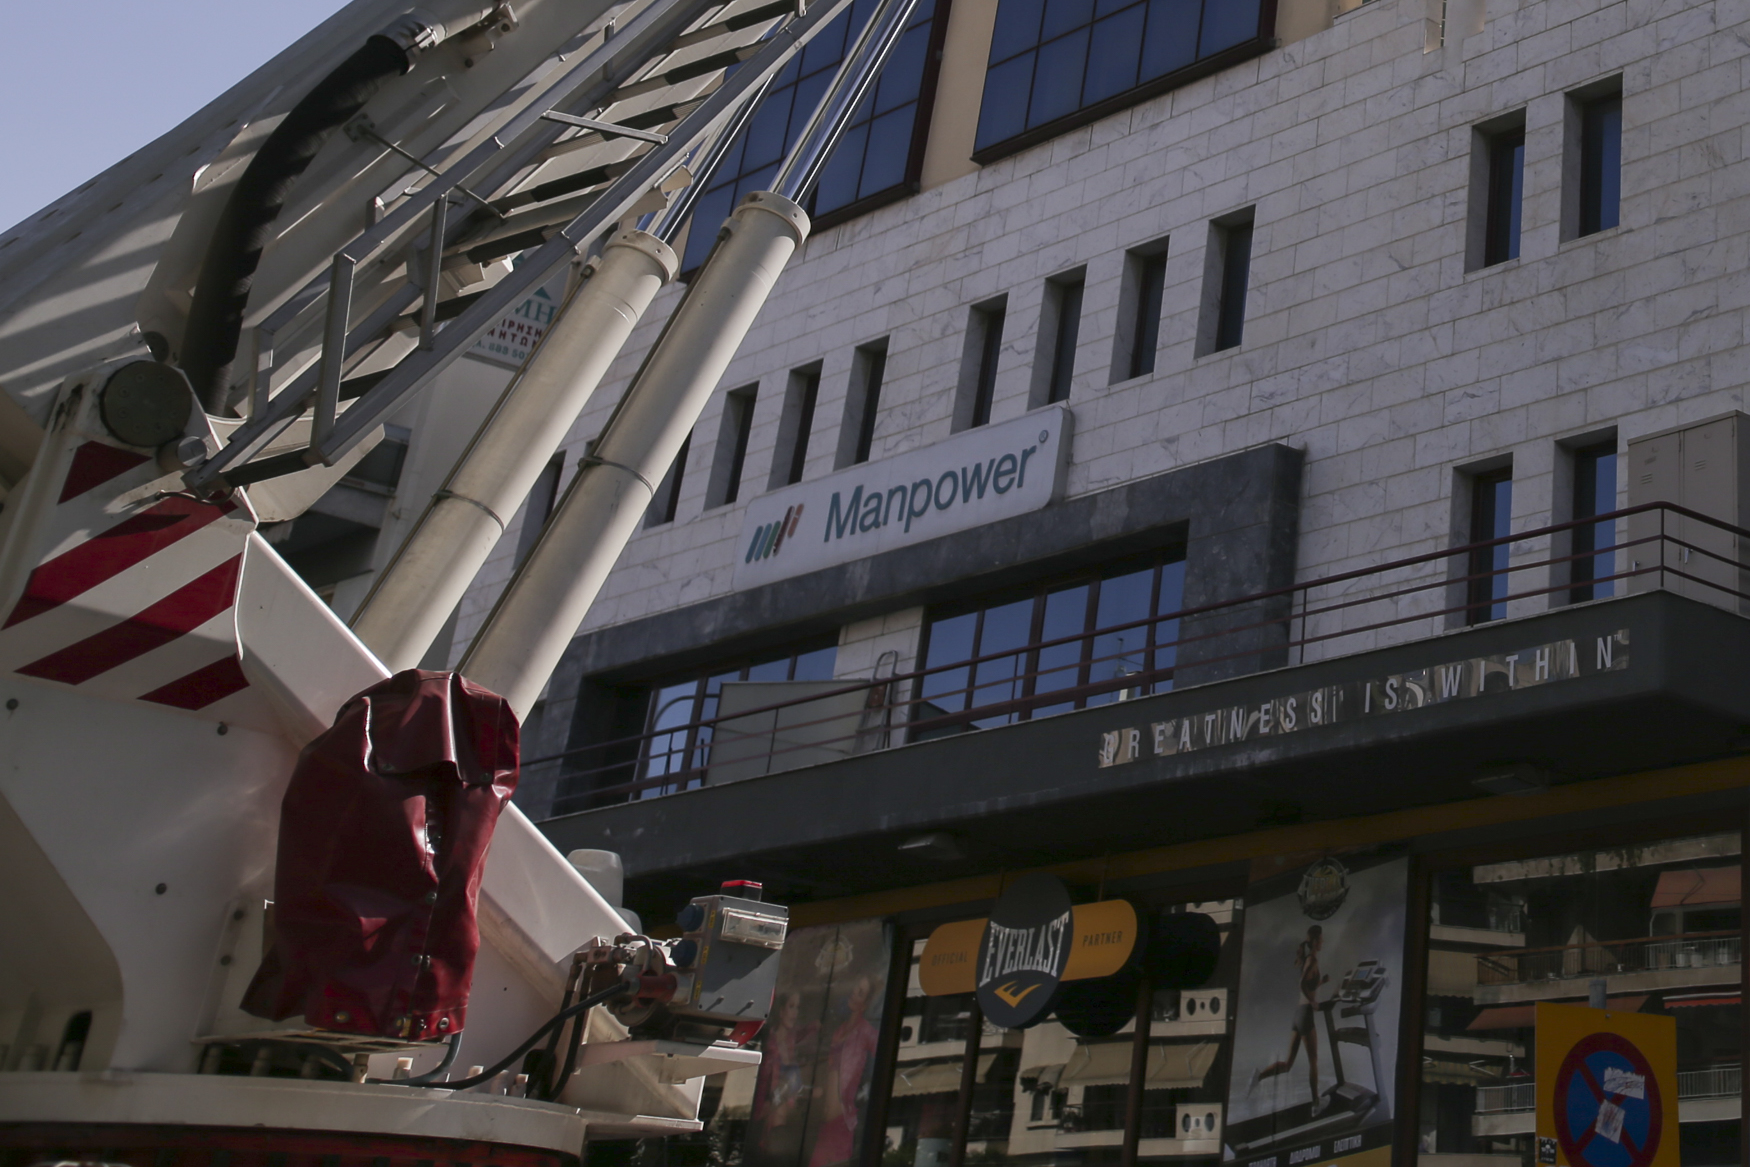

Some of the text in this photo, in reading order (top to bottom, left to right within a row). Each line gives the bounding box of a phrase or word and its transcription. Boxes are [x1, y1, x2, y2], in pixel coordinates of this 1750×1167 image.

[497, 318, 543, 339] ΙΡΗΣΗ
[823, 443, 1038, 543] Manpower
[1102, 635, 1613, 764] GREATNESS IS WITHIN
[931, 909, 1124, 988] OFFICIAL EVERLAST PARTNER
